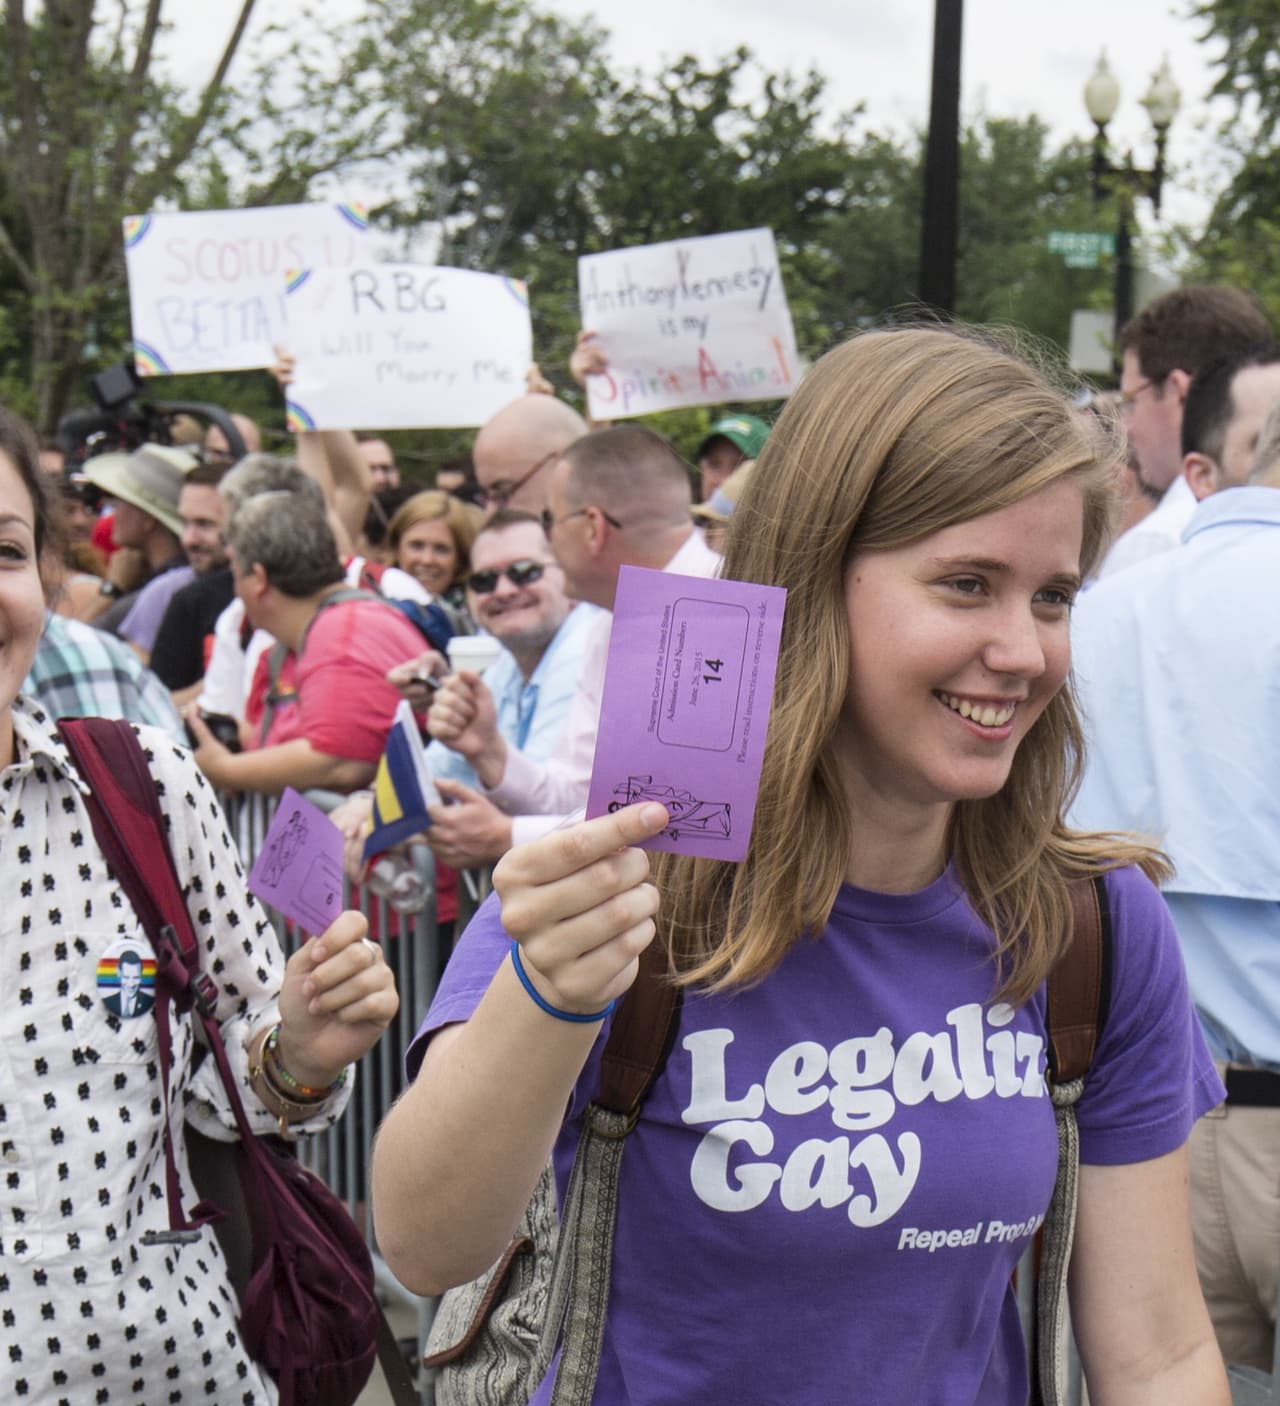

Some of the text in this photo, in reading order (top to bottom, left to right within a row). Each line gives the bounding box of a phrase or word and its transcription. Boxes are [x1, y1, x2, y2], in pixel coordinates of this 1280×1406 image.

[165, 233, 304, 285] SCOTUS
[349, 268, 447, 316] RBG
[658, 314, 710, 341] is my
[703, 658, 725, 685] 14
[736, 738, 748, 764] Please
[743, 665, 758, 717] instructions
[681, 1002, 1049, 1131] Legaliz
[690, 1120, 922, 1229] Gay
[897, 1221, 984, 1253] Repeal
